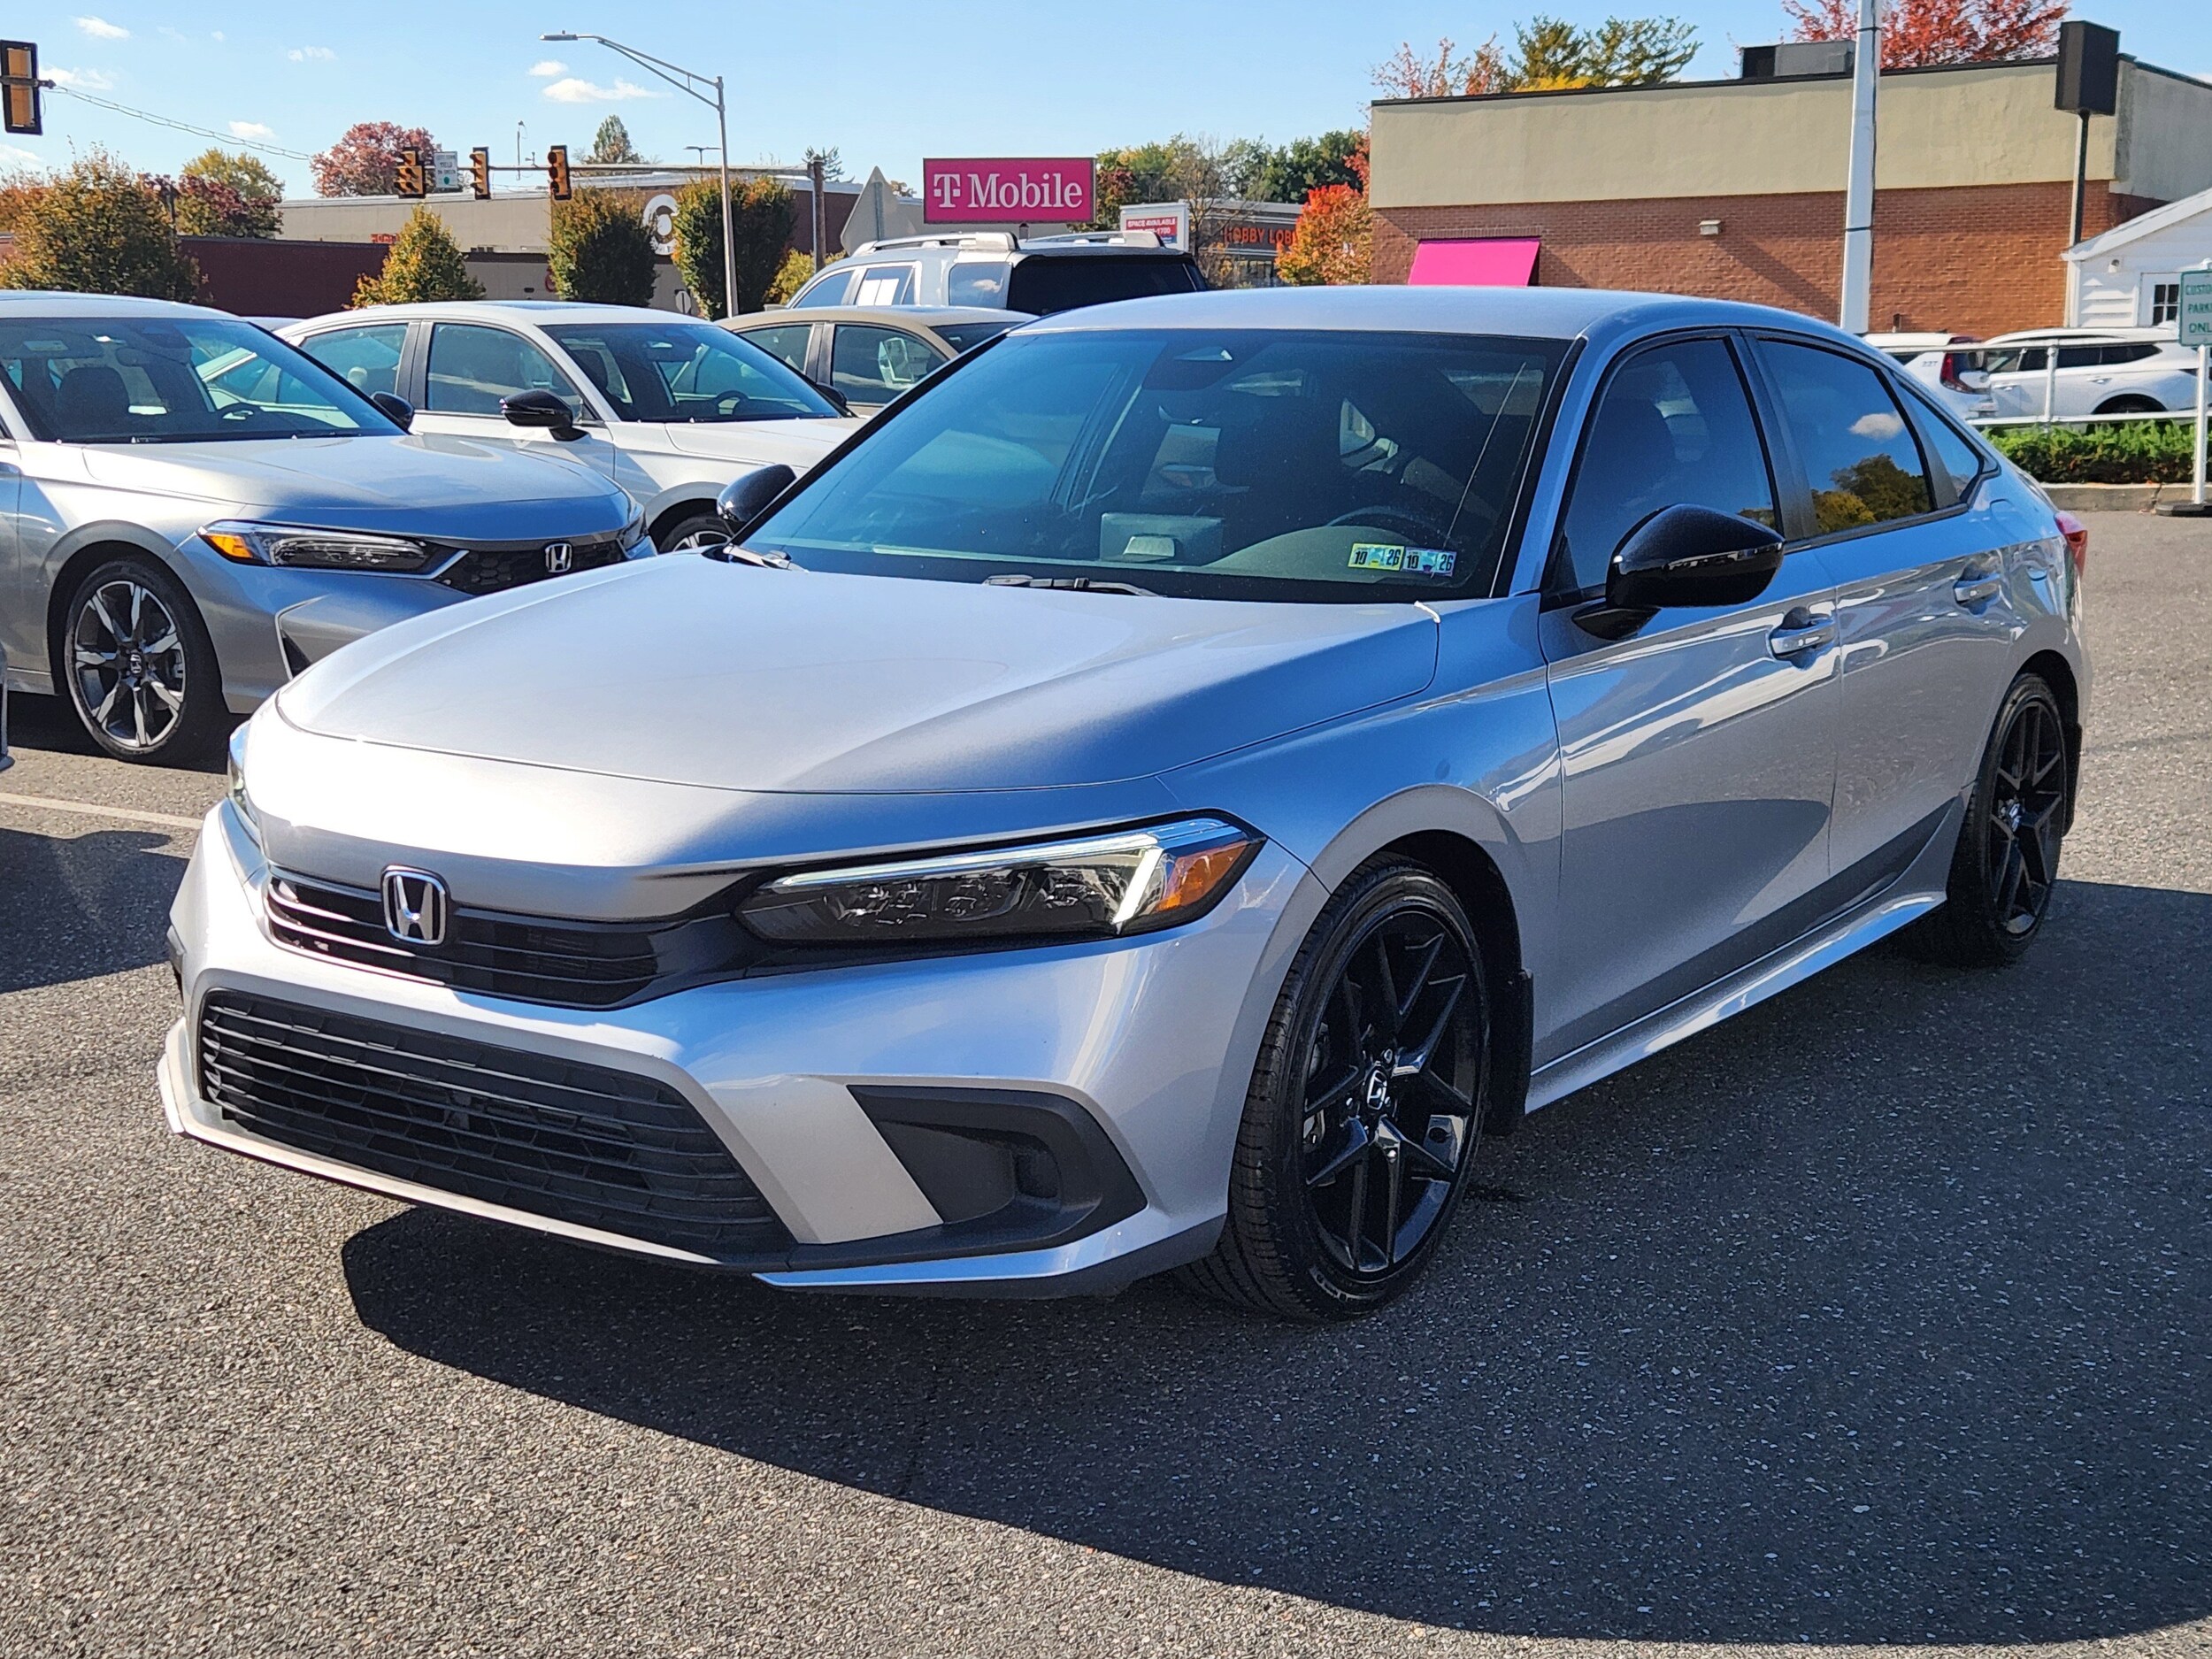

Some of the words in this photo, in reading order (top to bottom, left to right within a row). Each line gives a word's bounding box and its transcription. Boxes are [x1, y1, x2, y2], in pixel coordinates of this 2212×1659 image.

[933, 173, 961, 208] T
[967, 173, 1083, 208] Mobile
[1146, 218, 1176, 227] AVAILABLE
[1224, 226, 1264, 243] HOBBY
[1386, 549, 1401, 566] 26
[1439, 554, 1453, 572] 26
